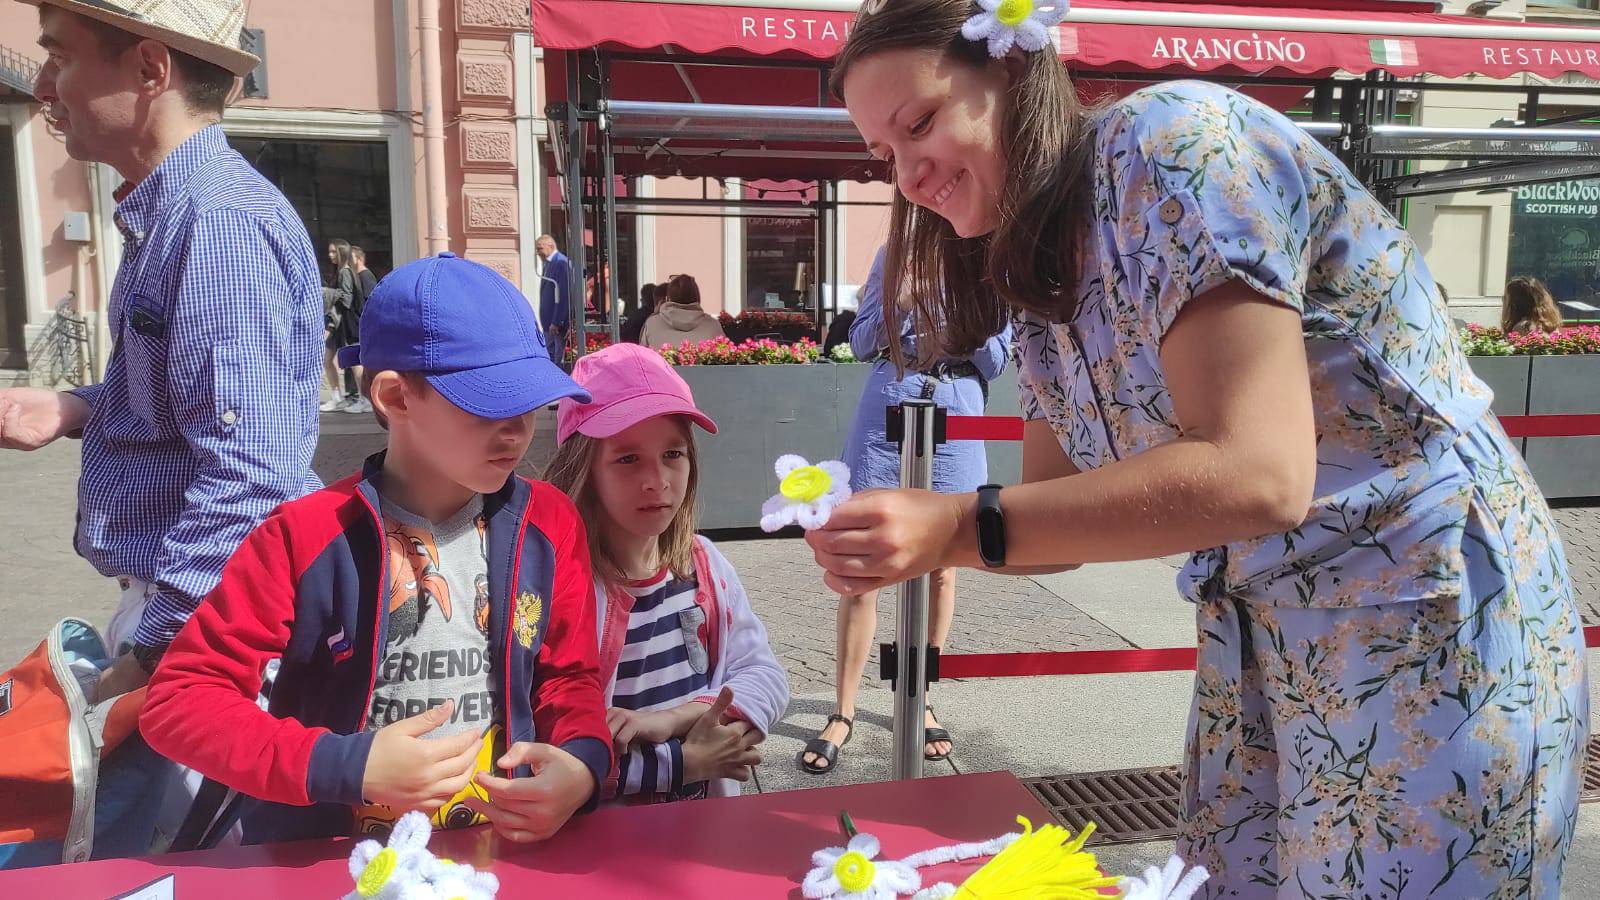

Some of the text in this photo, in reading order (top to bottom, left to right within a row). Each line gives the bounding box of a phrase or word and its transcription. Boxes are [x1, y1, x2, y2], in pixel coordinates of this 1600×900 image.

[1483, 47, 1600, 66] RESTAUR
[1525, 203, 1598, 214] SCOTTISH PUB
